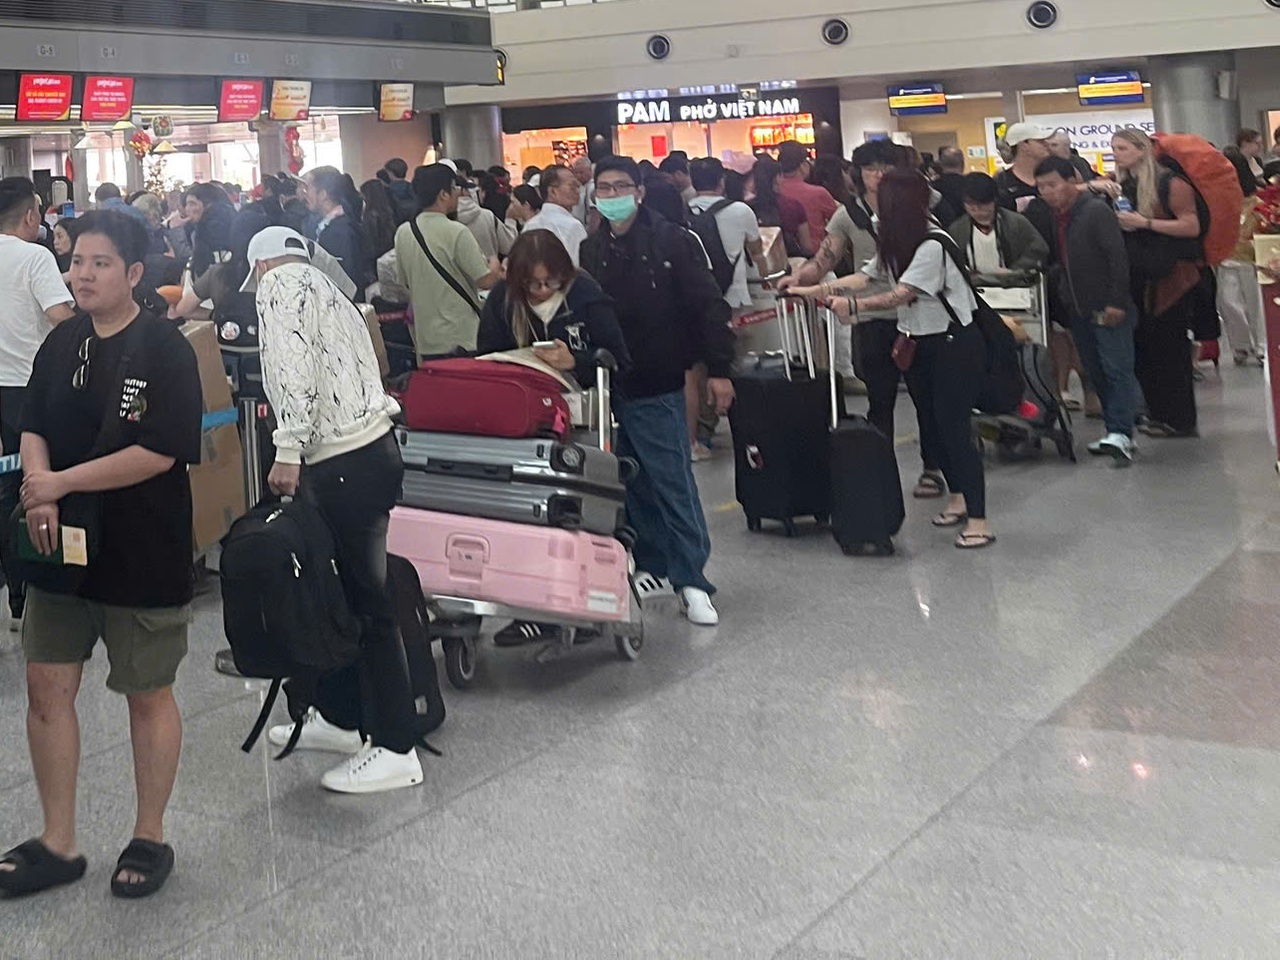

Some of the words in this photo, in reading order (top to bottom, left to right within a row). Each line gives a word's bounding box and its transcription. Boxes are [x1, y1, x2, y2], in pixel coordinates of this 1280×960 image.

[617, 100, 671, 124] PAM
[680, 98, 717, 120] PHỞ
[720, 98, 756, 120] VIỆT
[758, 98, 800, 114] NAM
